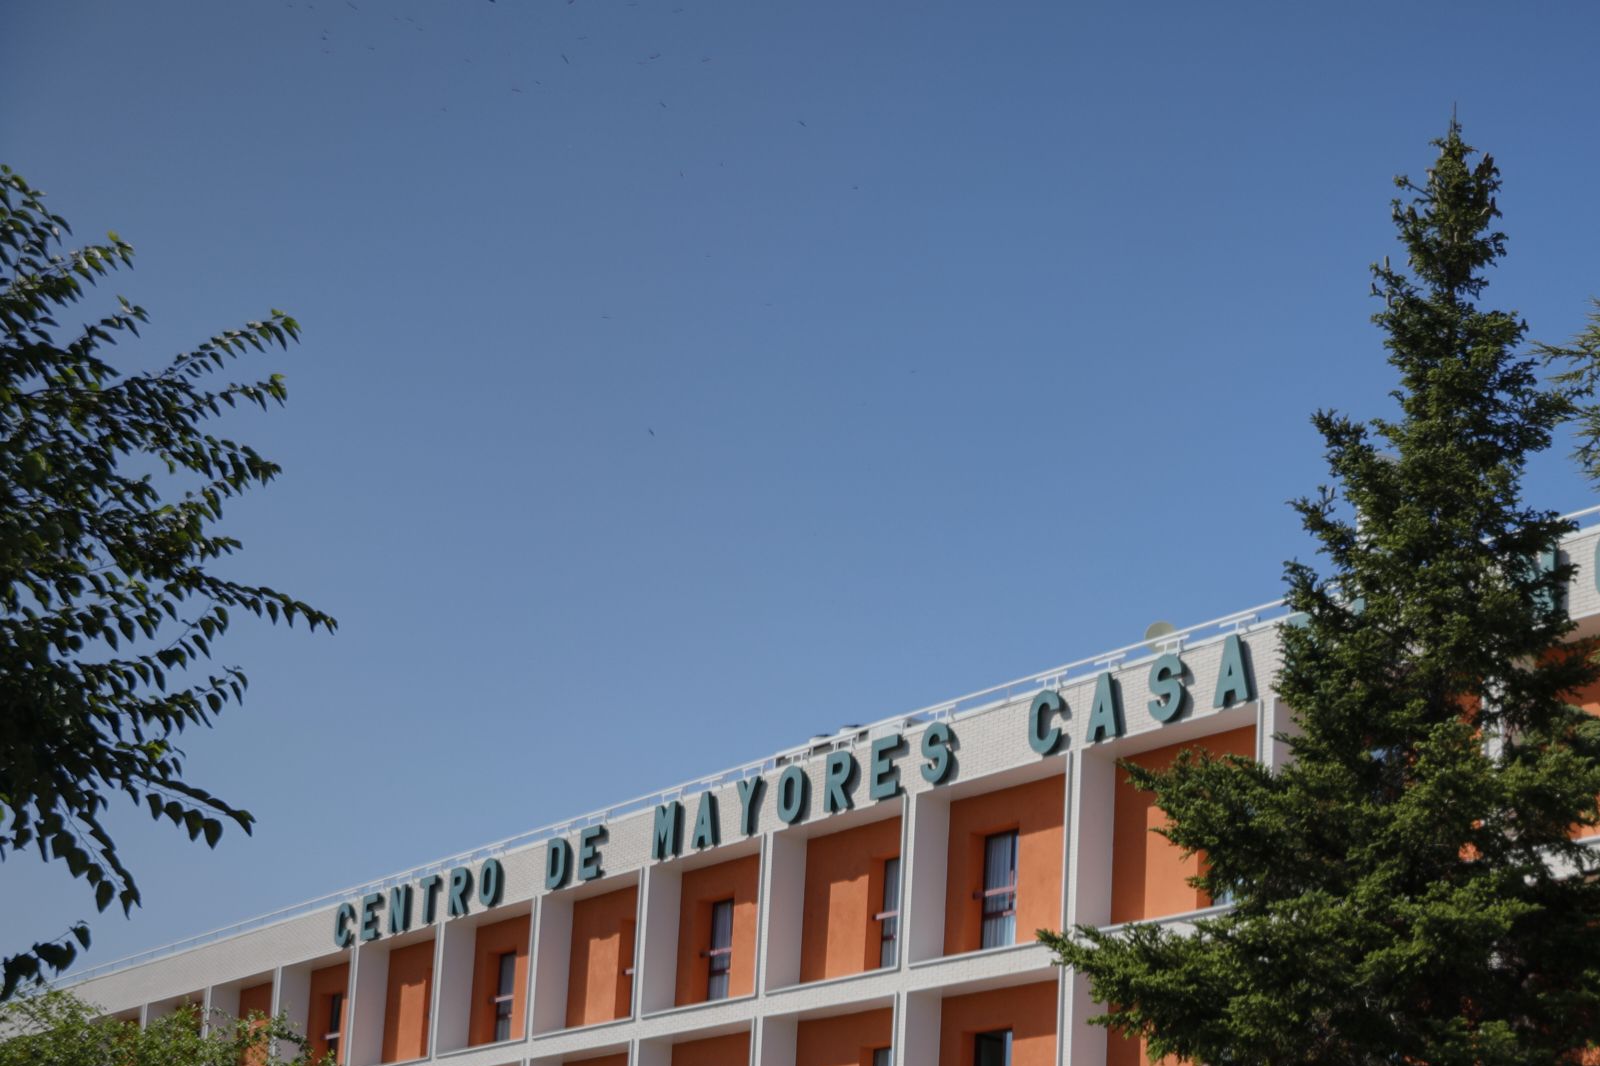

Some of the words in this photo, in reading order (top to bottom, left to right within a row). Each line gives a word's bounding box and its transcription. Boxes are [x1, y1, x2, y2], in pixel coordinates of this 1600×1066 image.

[334, 858, 504, 947] CENTRO
[545, 824, 606, 891] DE
[651, 721, 955, 860] MAYORES
